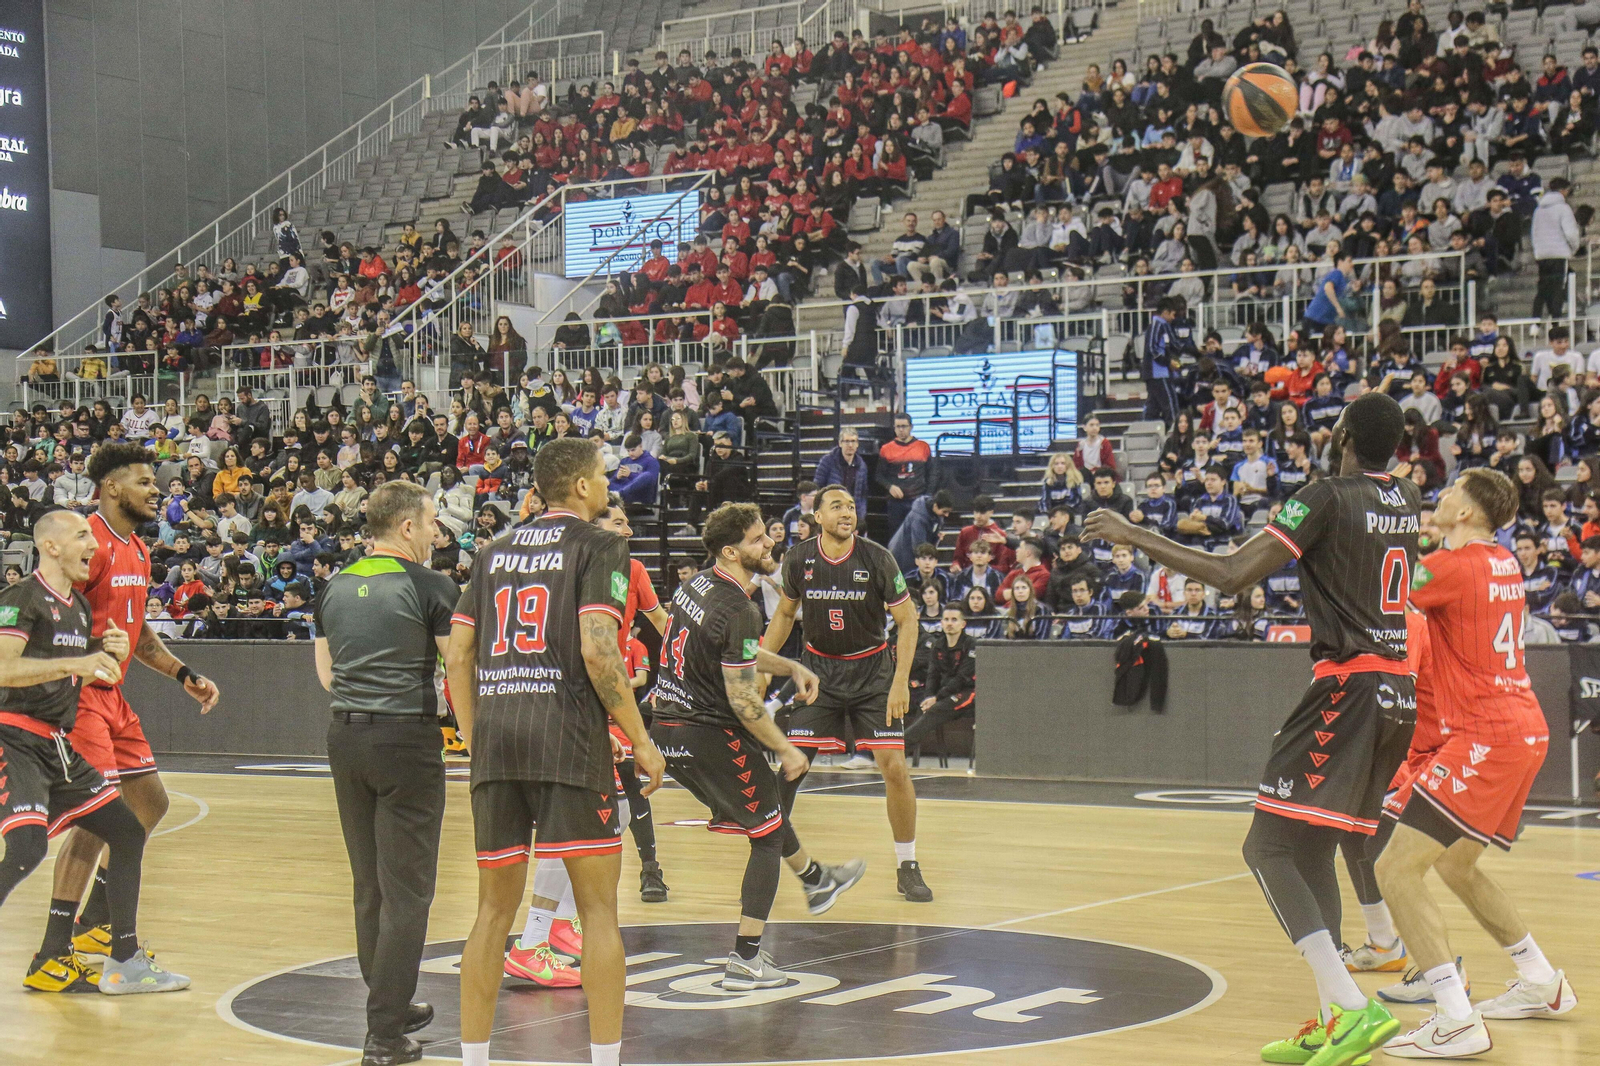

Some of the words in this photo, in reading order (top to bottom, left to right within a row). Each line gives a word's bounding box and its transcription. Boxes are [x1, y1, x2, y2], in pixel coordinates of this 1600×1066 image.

[1366, 511, 1419, 534] PULEVA
[489, 552, 564, 575] PULEVA
[672, 585, 706, 627] PULEVA
[491, 584, 550, 657] 19
[828, 608, 845, 631] 5
[479, 685, 495, 697] DE
[496, 682, 557, 696] GRANADA
